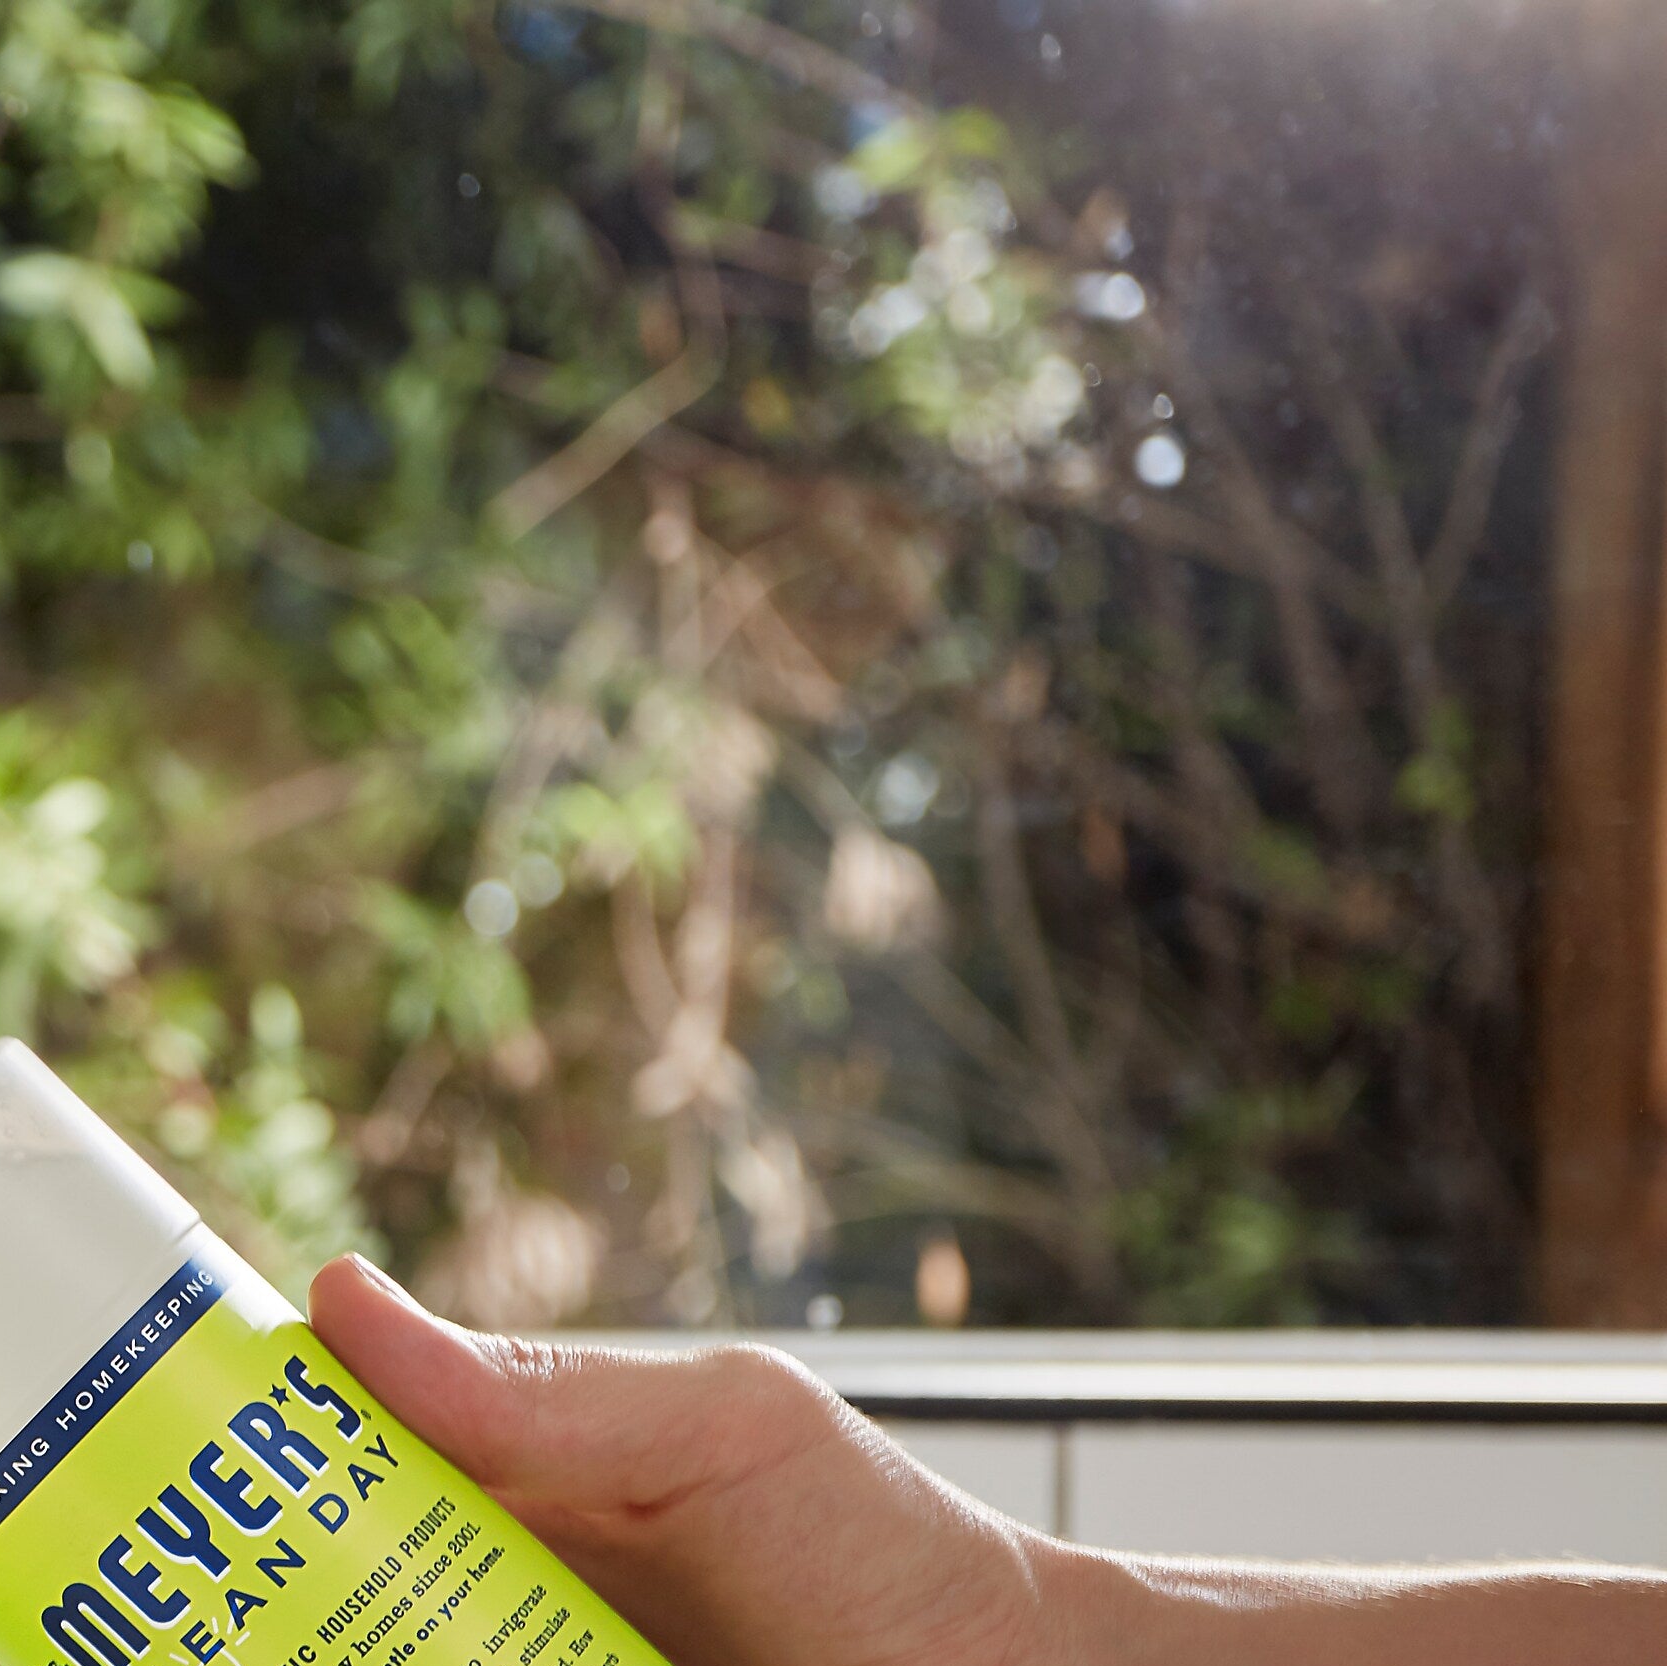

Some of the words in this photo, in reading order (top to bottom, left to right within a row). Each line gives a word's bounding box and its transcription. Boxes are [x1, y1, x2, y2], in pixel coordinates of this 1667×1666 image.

[55, 1267, 216, 1431] HOMEKEEPING
[306, 1432, 399, 1536] DAY
[315, 1555, 403, 1646] HOUSEHOLD
[398, 1495, 456, 1560] PRODUCTS
[349, 1596, 414, 1659] homes
[411, 1553, 453, 1599] since
[416, 1617, 440, 1642] on
[437, 1578, 473, 1623] your
[465, 1546, 506, 1583] home.
[481, 1584, 547, 1656] invigorate
[519, 1606, 571, 1666] stimulate
